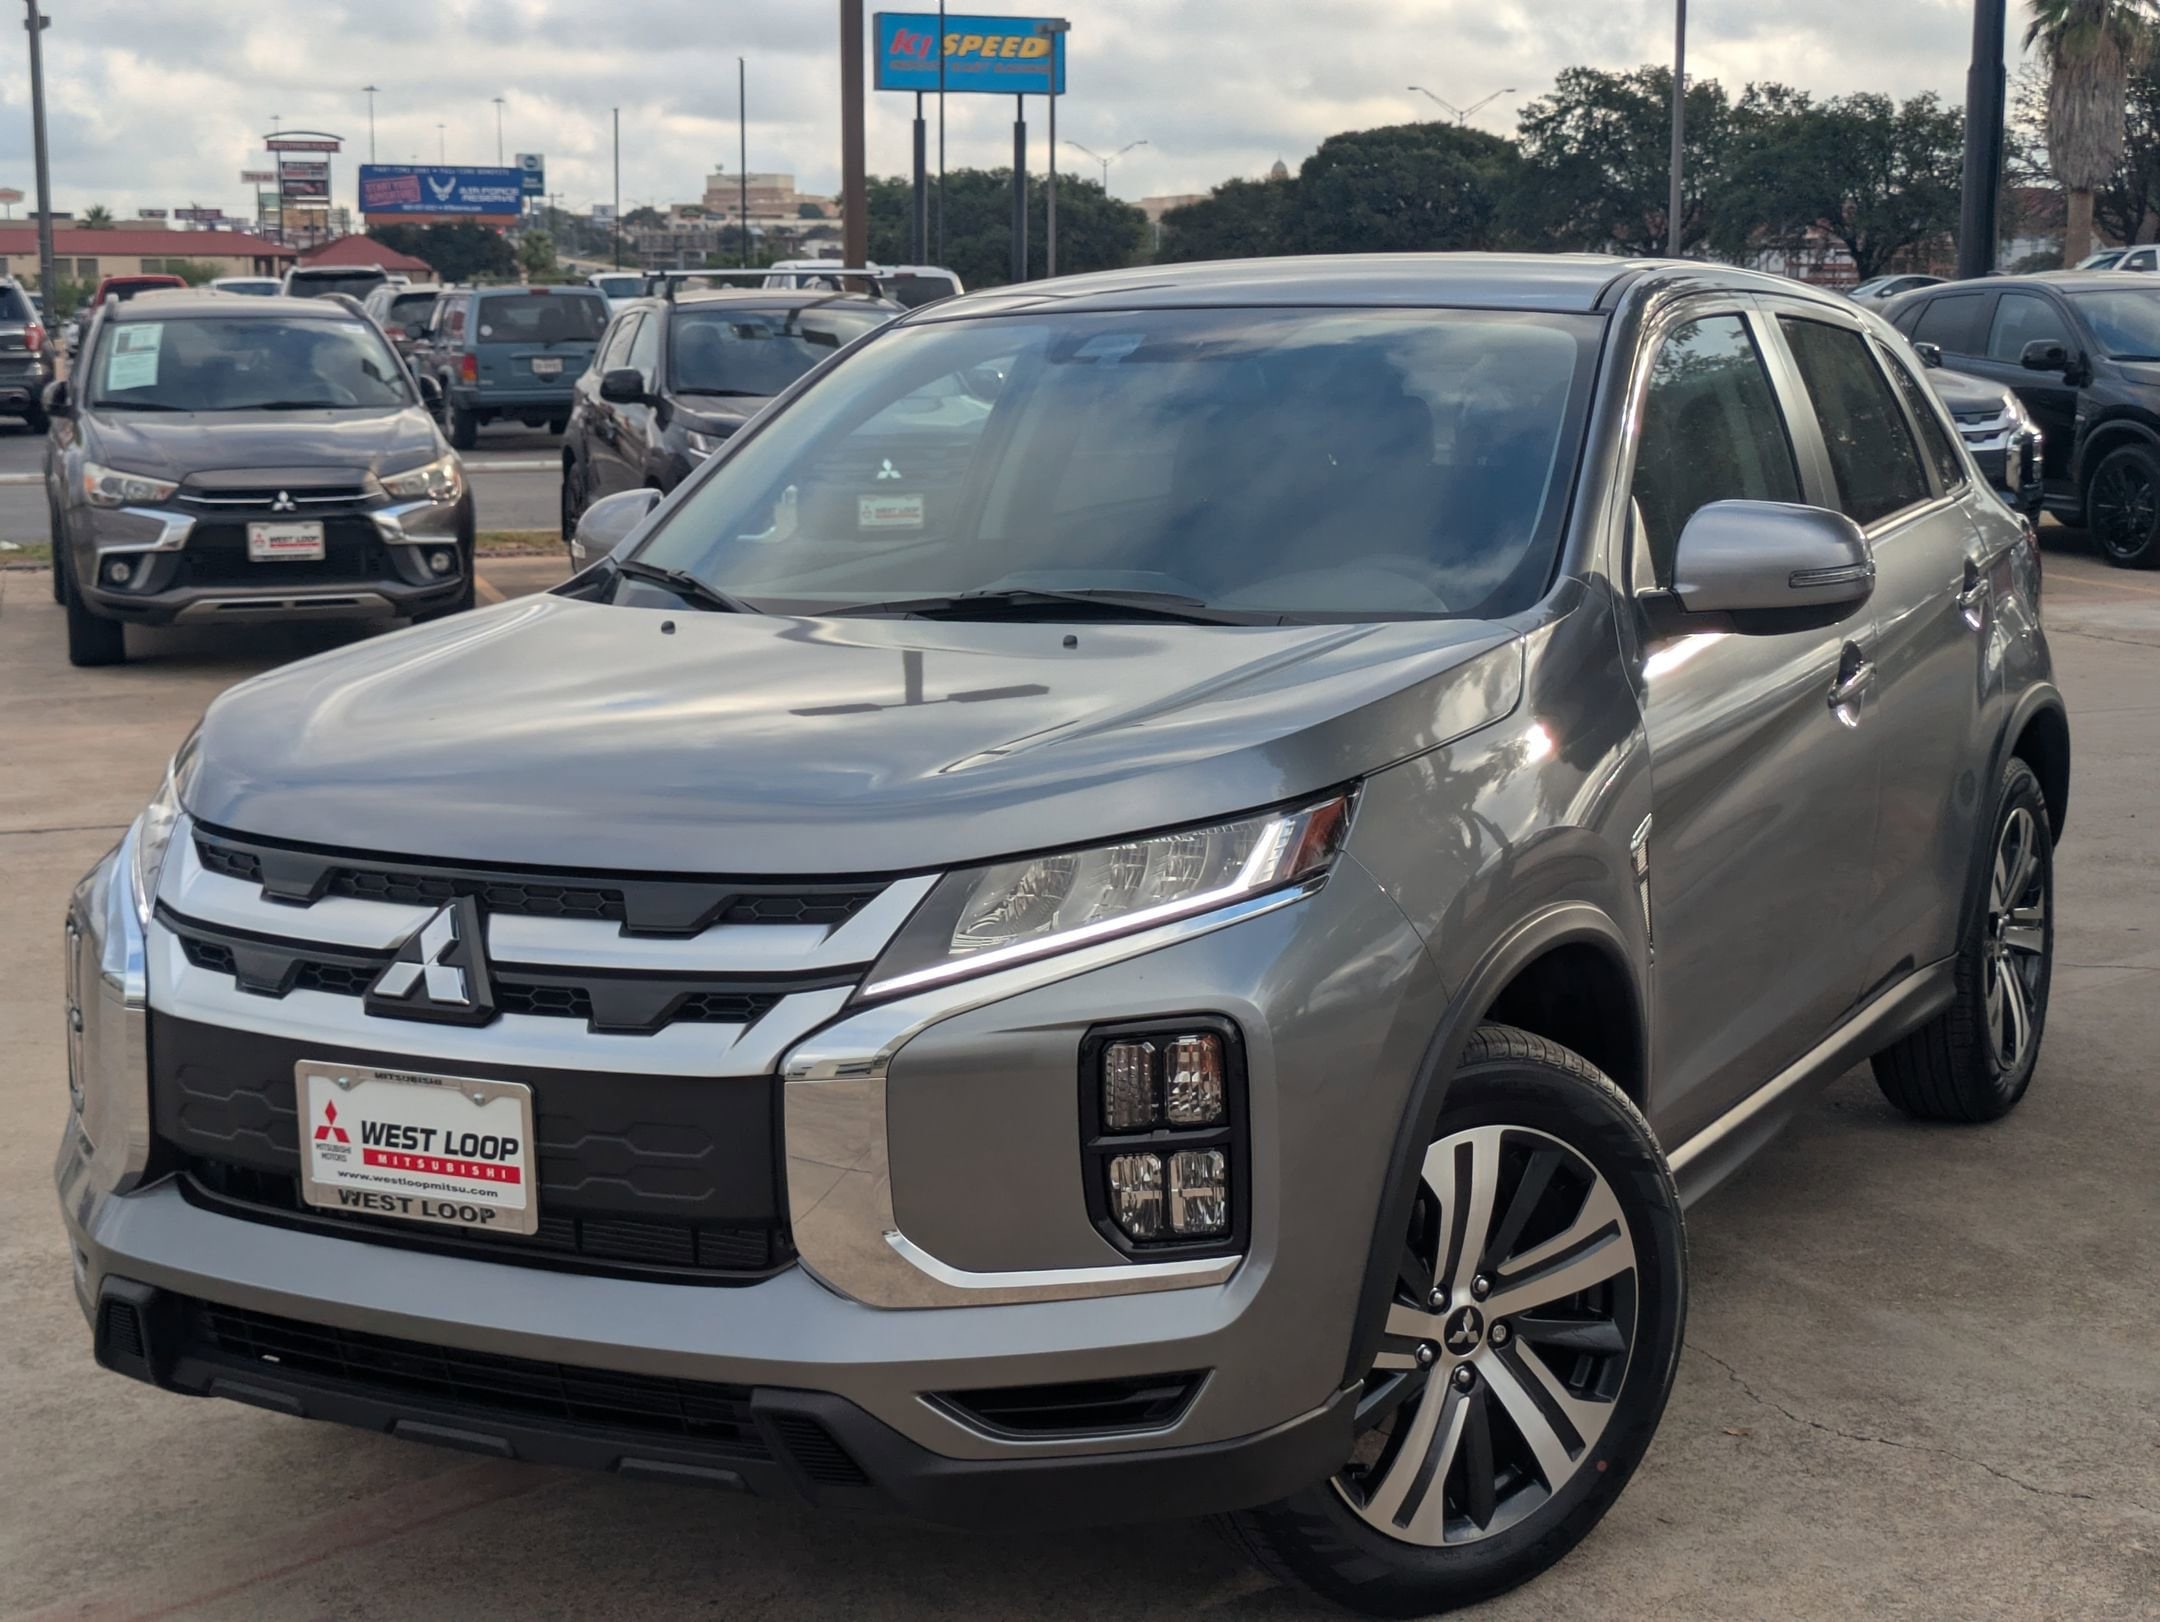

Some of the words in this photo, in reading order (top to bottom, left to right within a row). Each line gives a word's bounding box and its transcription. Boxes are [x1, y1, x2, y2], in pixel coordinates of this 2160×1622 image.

[940, 33, 1050, 58] SPEED
[459, 187, 479, 195] AIR
[481, 187, 519, 196] FORCE
[462, 195, 516, 203] RESERVE
[361, 1120, 438, 1152] WEST
[444, 1131, 519, 1161] LOOP
[321, 1152, 348, 1162] MOTORS
[377, 1153, 507, 1180] MITSUBISHI
[337, 1169, 498, 1198] www.westloopmitsu.com
[338, 1189, 413, 1214] WEST
[421, 1200, 496, 1224] LOOP
